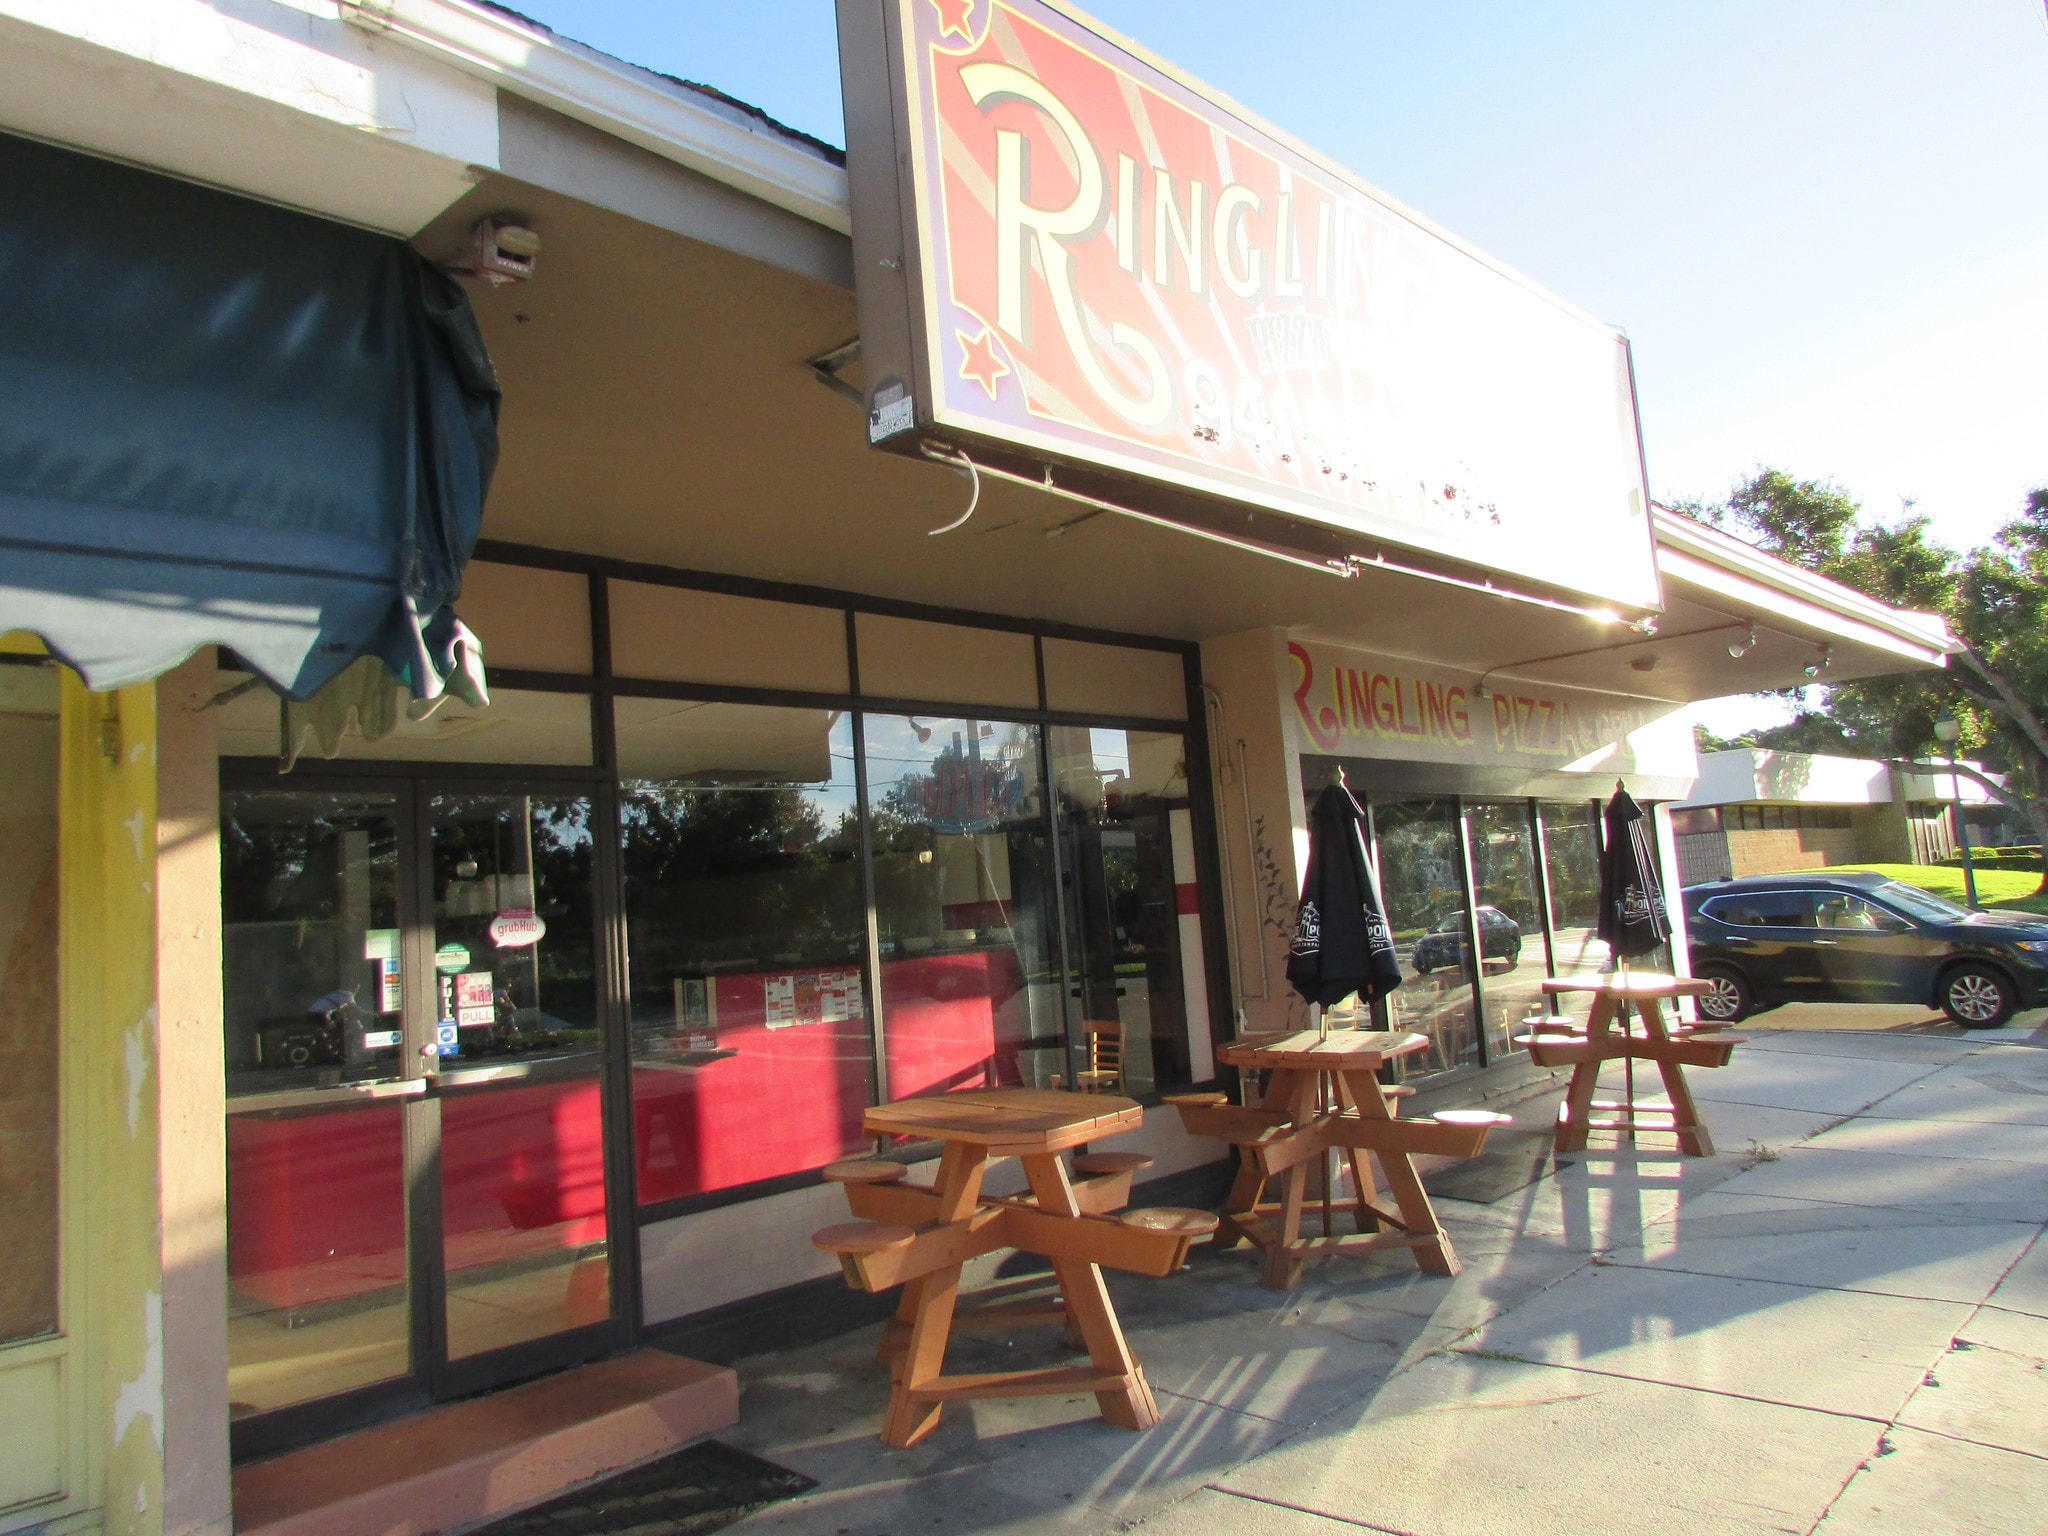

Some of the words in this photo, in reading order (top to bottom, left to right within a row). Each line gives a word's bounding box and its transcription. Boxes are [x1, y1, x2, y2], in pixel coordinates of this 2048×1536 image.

[959, 61, 1434, 432] RINGLIN
[1288, 641, 1475, 752] RINGLING
[498, 920, 537, 937] grubHub
[443, 977, 453, 1018] PULL
[462, 1011, 492, 1022] PULL
